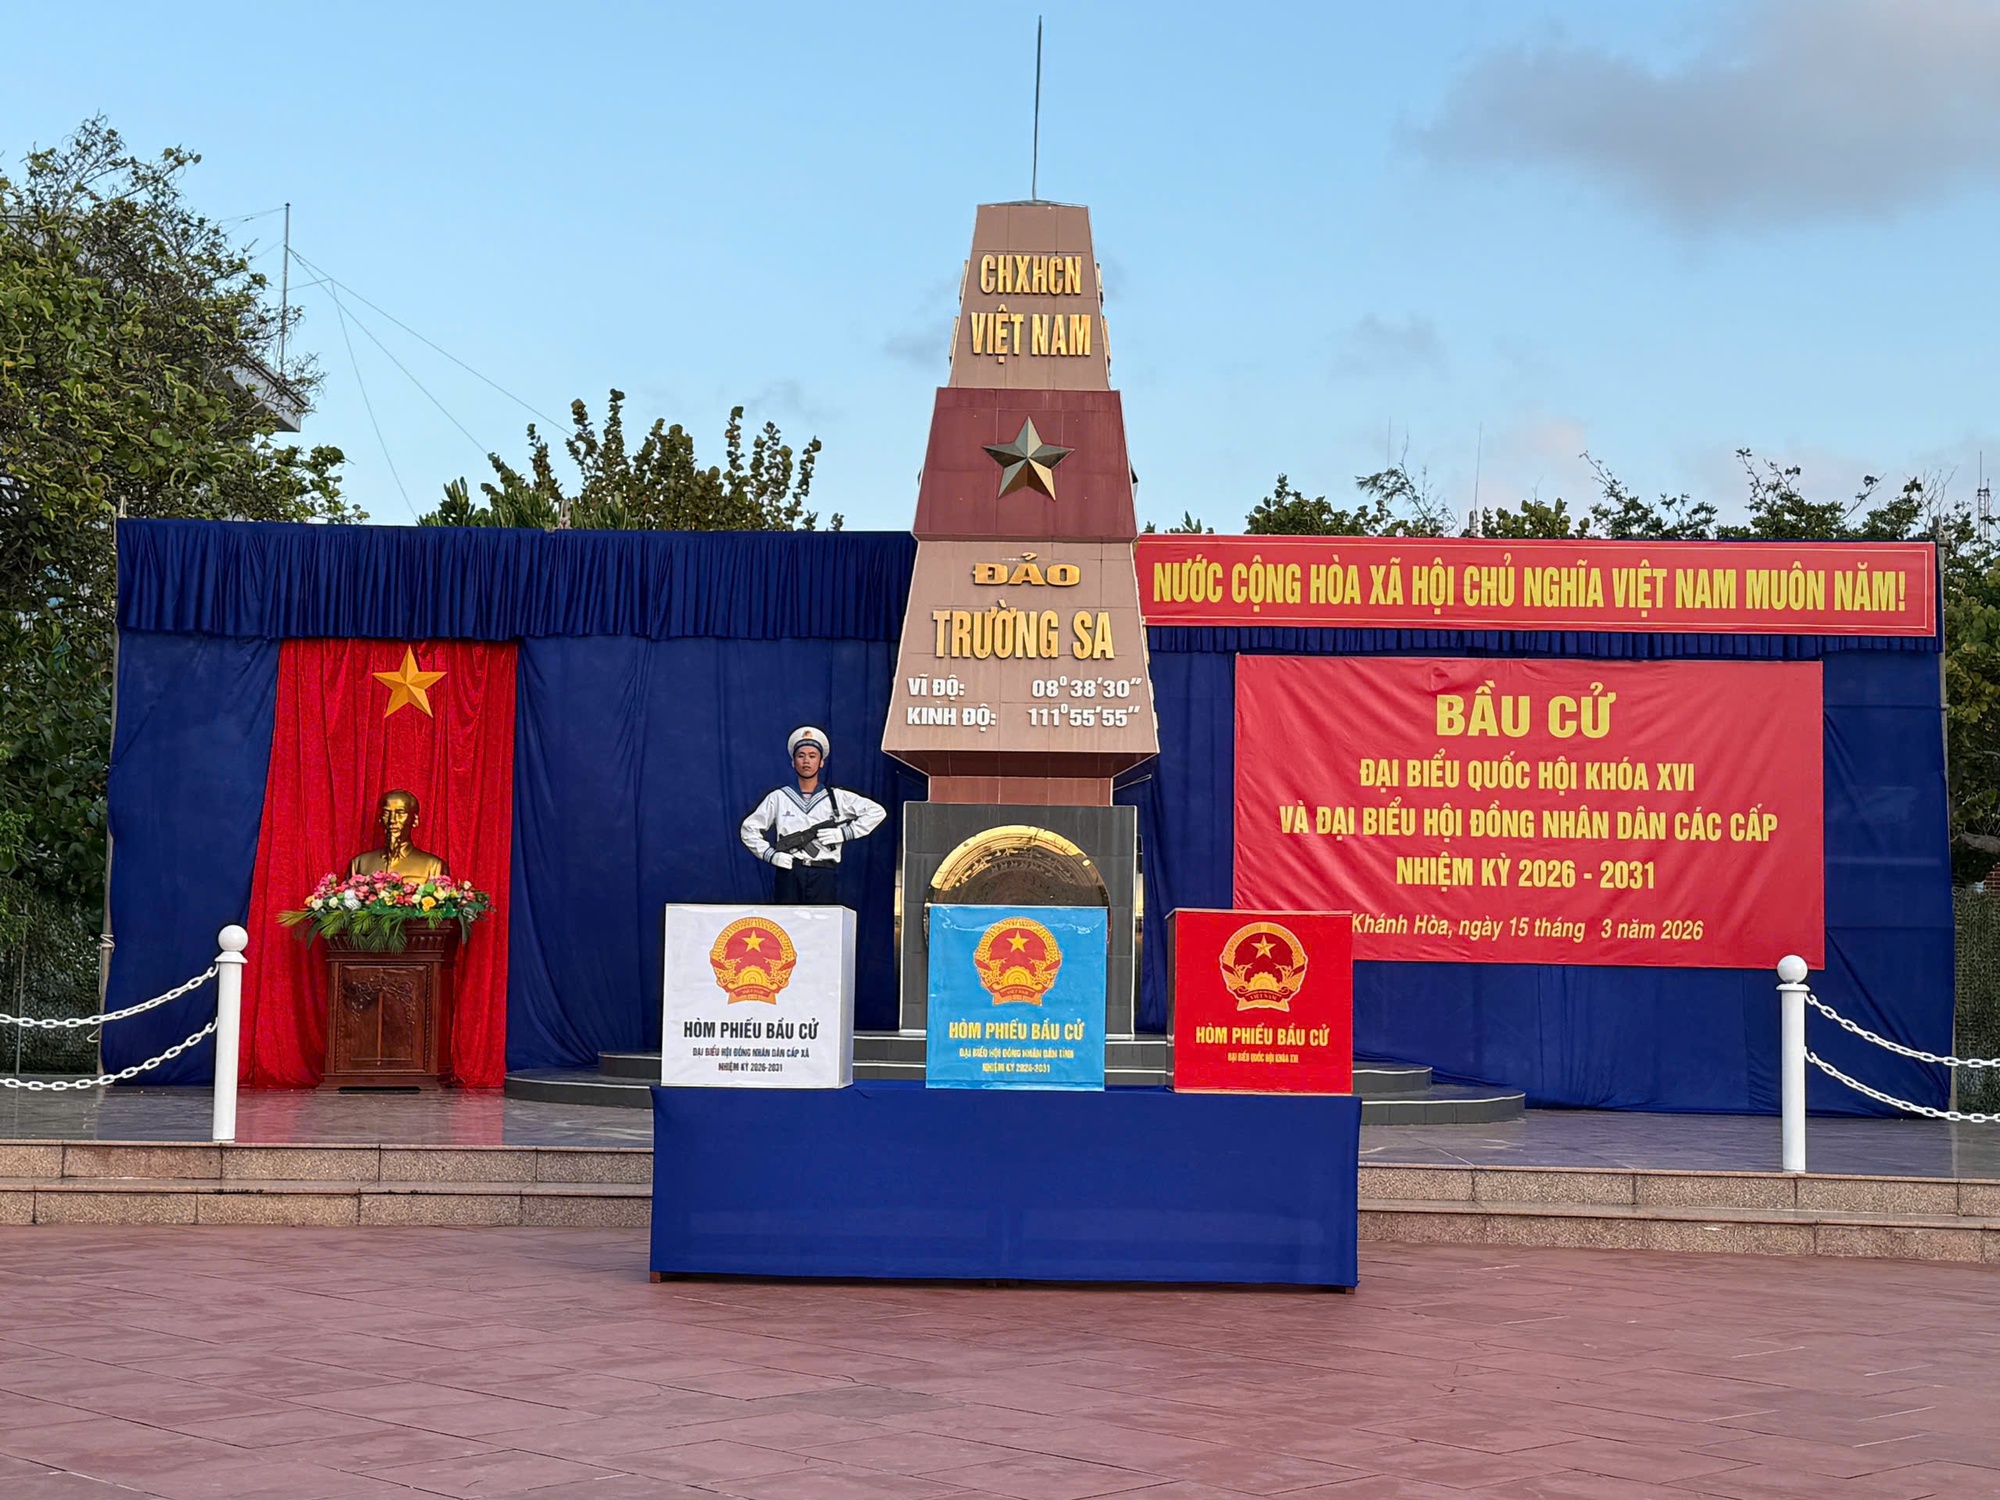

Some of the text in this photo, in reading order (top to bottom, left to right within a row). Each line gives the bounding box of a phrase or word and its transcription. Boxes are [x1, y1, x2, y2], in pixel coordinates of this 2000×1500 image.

[980, 254, 1082, 295] CHXHCN
[971, 304, 1091, 364] VIỆT NAM
[972, 552, 1080, 586] ĐẢO
[1153, 553, 1906, 618] NƯỚC CỘNG HÒA XÃ HỘI CHỦ NGHĨA VIỆT NAM MUÔN NĂM!
[932, 599, 1115, 660] TRƯỜNG SA
[907, 674, 928, 696] VĨ
[932, 674, 965, 700] ĐỘ:
[906, 707, 957, 726] KINH
[962, 703, 997, 731] ĐỘ:
[1436, 680, 1617, 738] BẦU CỬ
[1359, 748, 1695, 796] ĐẠI BIỂU QUỐC HỘI KHÓA XVI
[1279, 796, 1778, 843] VÀ ĐẠI BIỂU HỘI ĐỒNG NHÂN DÂN CÁC CẤP
[1396, 851, 1473, 892] NHIỆM
[1481, 852, 1511, 887] KỲ
[1518, 858, 1576, 888] 2026
[1599, 860, 1655, 889] 2031
[1352, 913, 1704, 943] Khánh Hòa, ngày 15 tháng 3 năm 2026
[683, 1017, 819, 1040] HÒM PHIẾU BẦU CỬ
[949, 1018, 1085, 1041] HÒM PHIẾU BẦU CỬ
[1195, 1022, 1330, 1047] HÒM PHIẾU BẦU CỬ
[718, 1061, 783, 1073] NHIỆM KỲ 2026-2031
